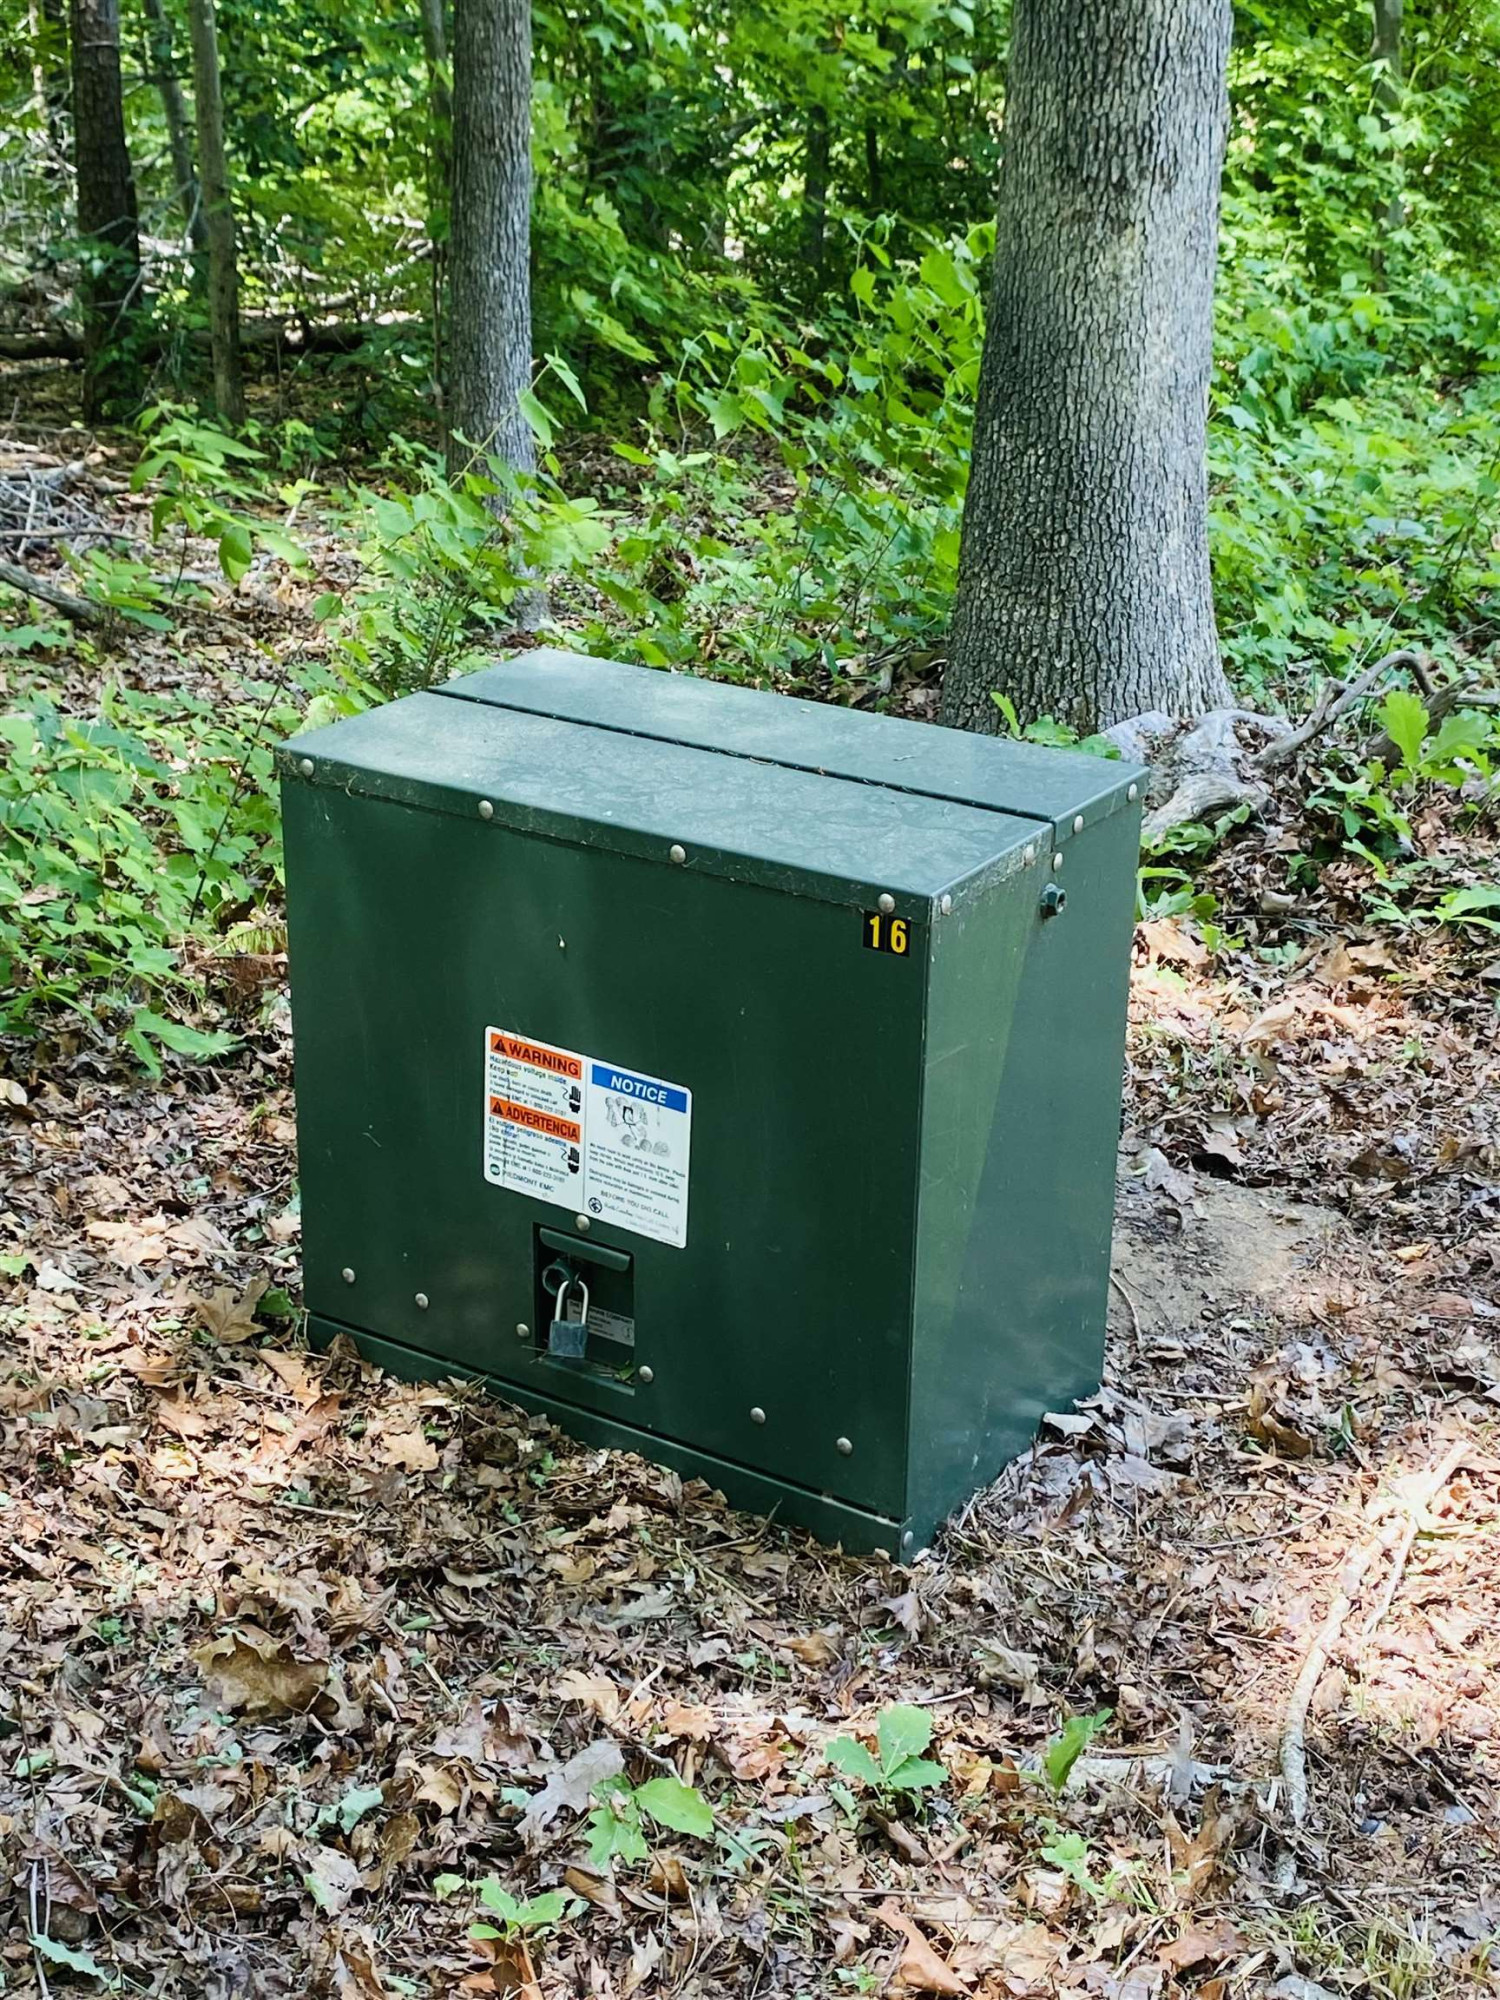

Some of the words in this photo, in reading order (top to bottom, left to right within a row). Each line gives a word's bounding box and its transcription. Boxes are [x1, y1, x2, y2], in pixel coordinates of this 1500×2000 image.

[869, 915, 907, 953] 16
[509, 1043, 579, 1076] WARNING
[611, 1075, 668, 1104] NOTICE
[505, 1107, 578, 1139] ADVERTENCIA
[539, 1182, 555, 1192] EMC
